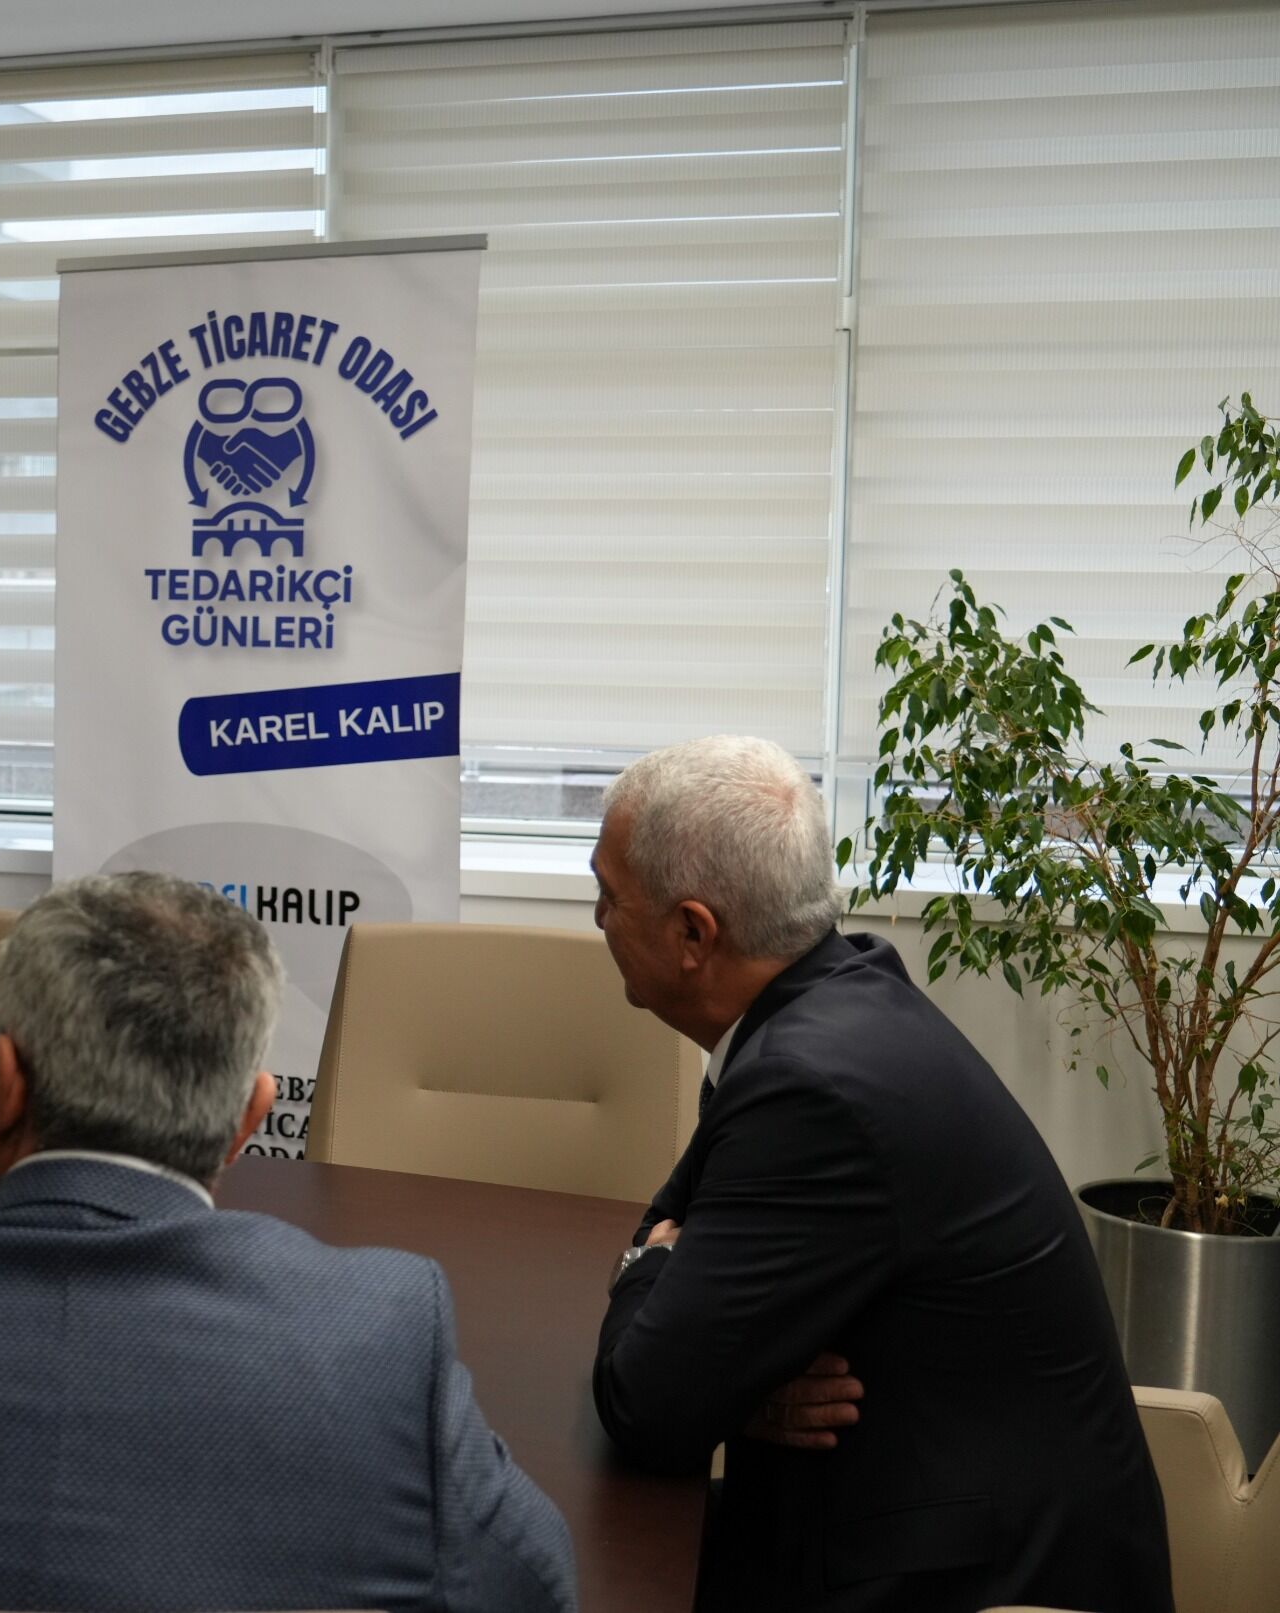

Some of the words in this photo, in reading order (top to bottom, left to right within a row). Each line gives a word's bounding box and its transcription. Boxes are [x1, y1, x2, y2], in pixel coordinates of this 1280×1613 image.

[94, 339, 191, 443] GEBZE
[189, 310, 339, 369] TİCARET
[337, 335, 438, 440] ODASI
[161, 606, 335, 649] GÜNLERİ
[209, 711, 329, 747] KAREL
[338, 700, 445, 737] KALIP
